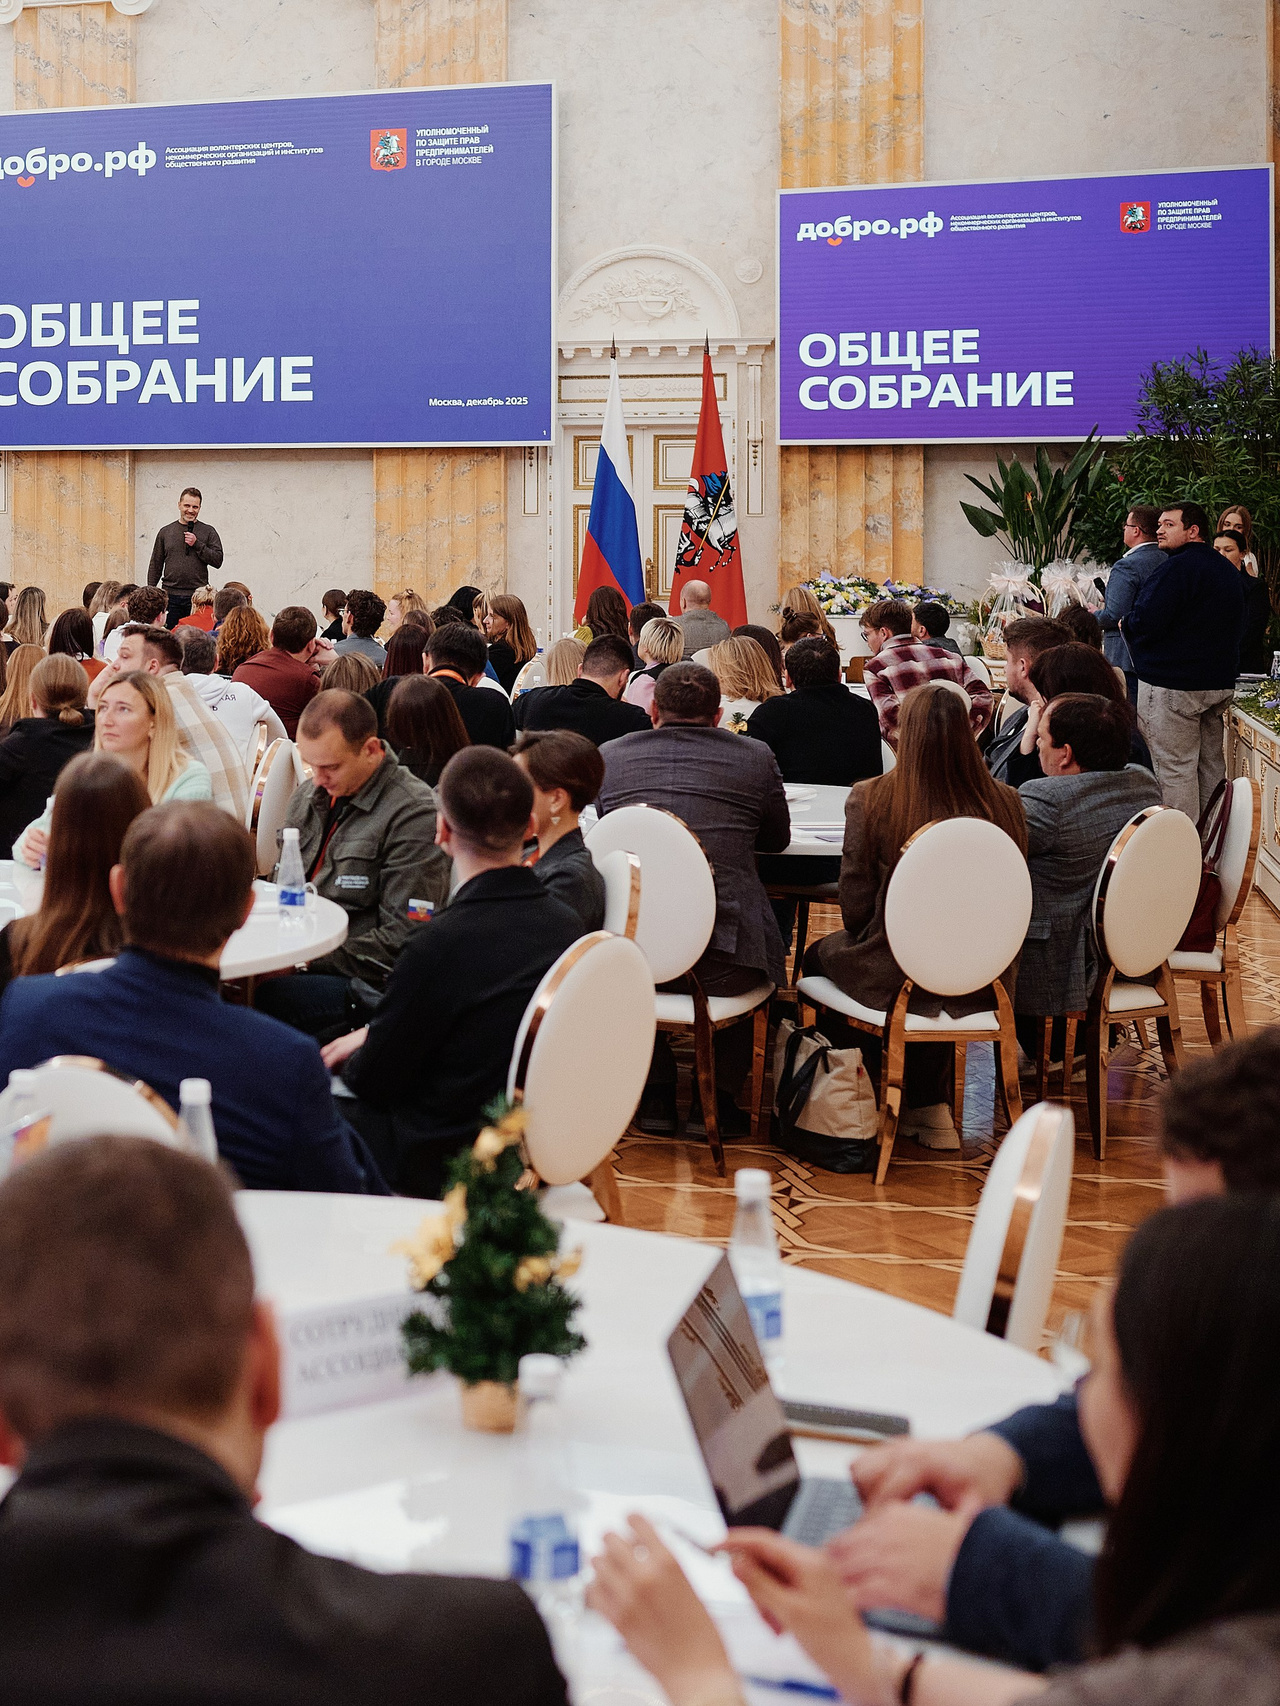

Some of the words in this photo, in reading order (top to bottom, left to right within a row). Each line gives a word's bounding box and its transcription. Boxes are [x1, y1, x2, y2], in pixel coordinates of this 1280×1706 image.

[416, 124, 489, 137] УПОЛНОМОЧЕННЫЙ
[416, 139, 427, 147] ПО
[428, 137, 459, 146] ЗАЩИТЕ
[460, 136, 480, 144] ПРАВ
[165, 146, 209, 154] Ассоциация
[209, 143, 260, 152] волонтерских
[261, 141, 294, 149] центров,
[416, 144, 494, 157] ПРЕДПРИНИМАТЕЛЕЙ
[165, 152, 227, 161] некоммерческих
[227, 149, 274, 159] организаций
[281, 147, 324, 156] институтов
[165, 160, 222, 169] общественного
[222, 158, 256, 167] развития
[416, 159, 421, 167] В
[422, 157, 451, 166] ГОРОДЕ
[452, 156, 482, 165] МОСКВЕ
[1158, 198, 1218, 208] УПОЛНОМОЧЕННЫЙ
[950, 219, 1001, 227] некоммерческих
[1001, 217, 1041, 225] организаций
[1046, 215, 1082, 223] институтов
[1157, 213, 1222, 223] ПРЕДПРИНИМАТЕЛЕЙ
[796, 211, 944, 241] добро.рф
[997, 223, 1026, 231] развития
[1163, 222, 1187, 230] ГОРОДЕ
[798, 328, 980, 371] ОБЩЕЕ
[798, 371, 1074, 411] СОБРАНИЕ
[428, 398, 465, 407] Москва,
[466, 397, 504, 407] декабрь
[505, 397, 529, 405] 2025
